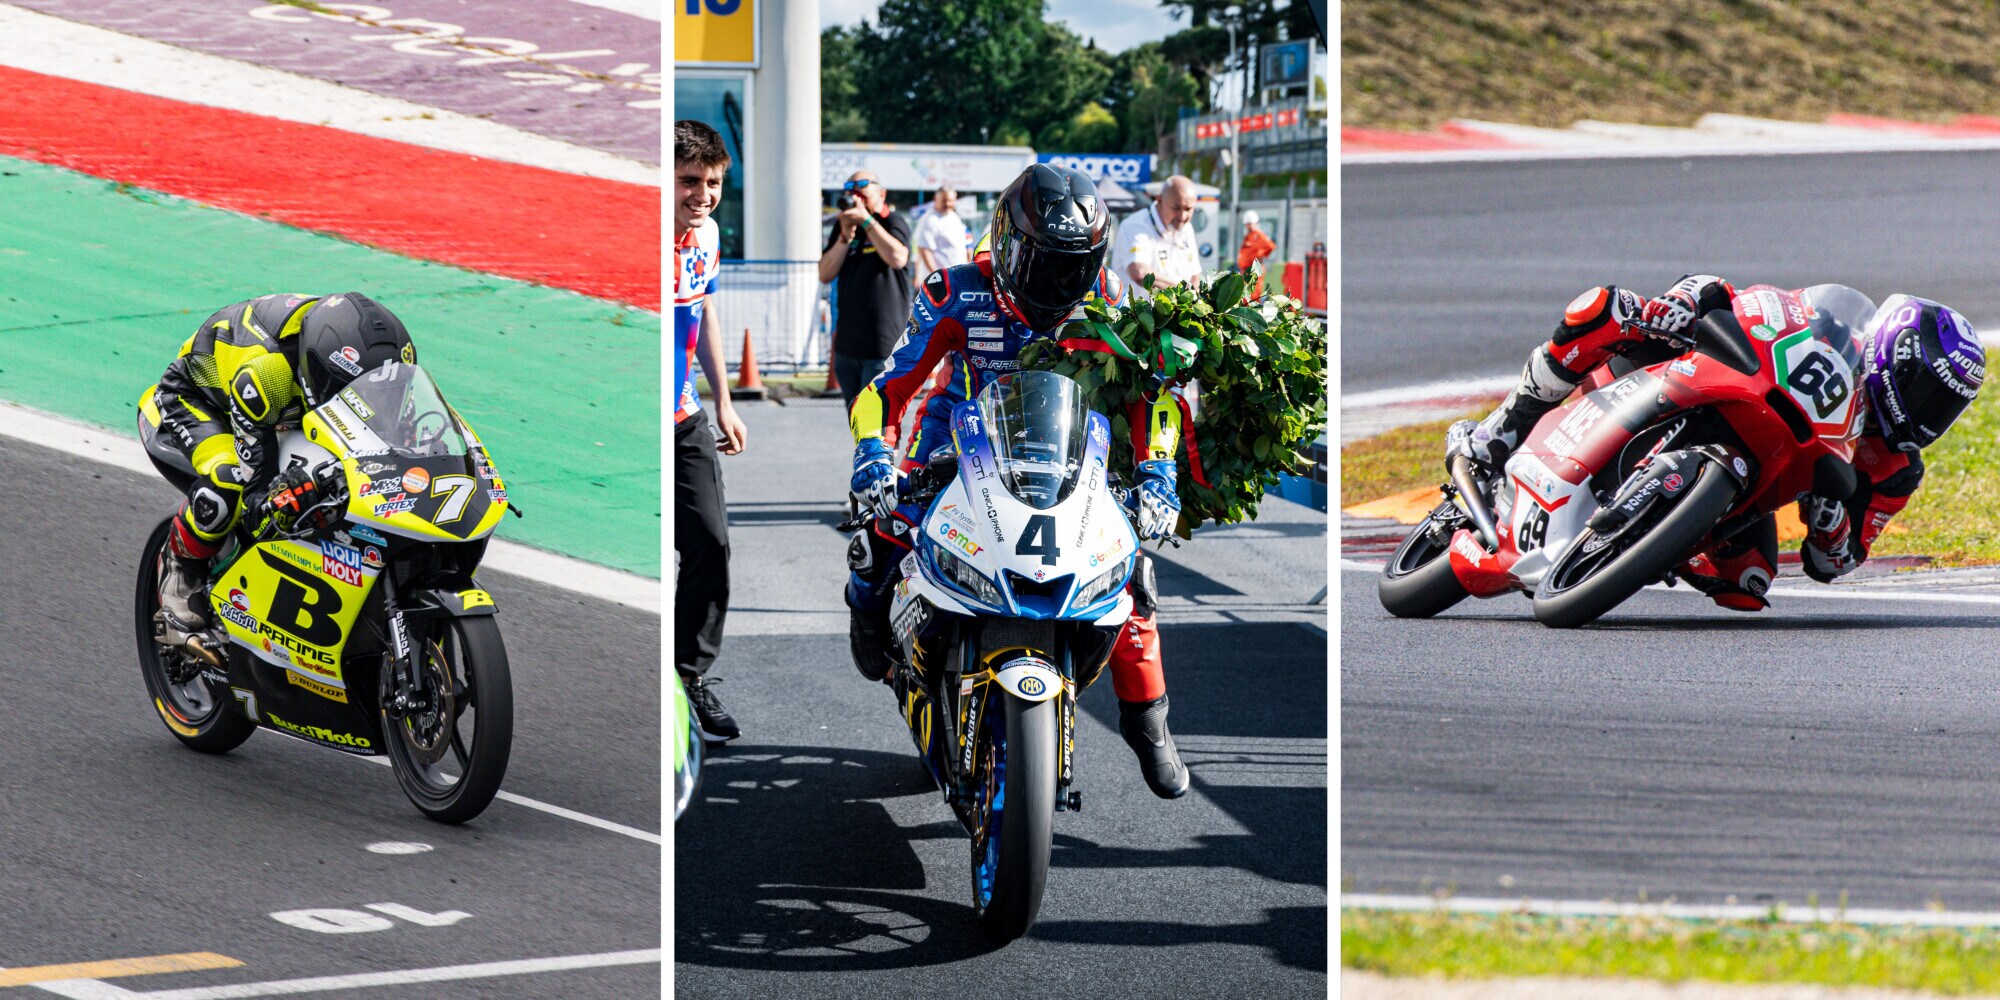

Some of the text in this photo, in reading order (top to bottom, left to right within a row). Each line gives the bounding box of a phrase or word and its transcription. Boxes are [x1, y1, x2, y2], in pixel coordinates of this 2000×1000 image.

[1786, 351, 1849, 420] 69
[1881, 369, 1907, 424] finetwork
[322, 405, 357, 441] BORRELLI
[375, 498, 414, 515] VERTEX
[432, 475, 476, 525] 7
[1622, 478, 1661, 512] DUNLOP
[981, 486, 1005, 544] CLINICA IPHONE
[1518, 500, 1550, 554] 69
[322, 541, 362, 567] LIQUI
[939, 522, 984, 557] Gemar
[1015, 514, 1061, 566] 4
[1089, 538, 1123, 567] Gemar
[1454, 532, 1483, 569] MOTUL
[270, 543, 322, 575] TECNOSTAMPI Srl
[323, 556, 362, 586] MOLY
[256, 546, 343, 648] B
[258, 621, 336, 665] RACING
[396, 611, 410, 657] DUNLOP
[232, 686, 262, 722] 7
[298, 675, 344, 698] DUNLOP
[266, 711, 371, 747] BucciMoto
[964, 708, 976, 771] DUNLOP
